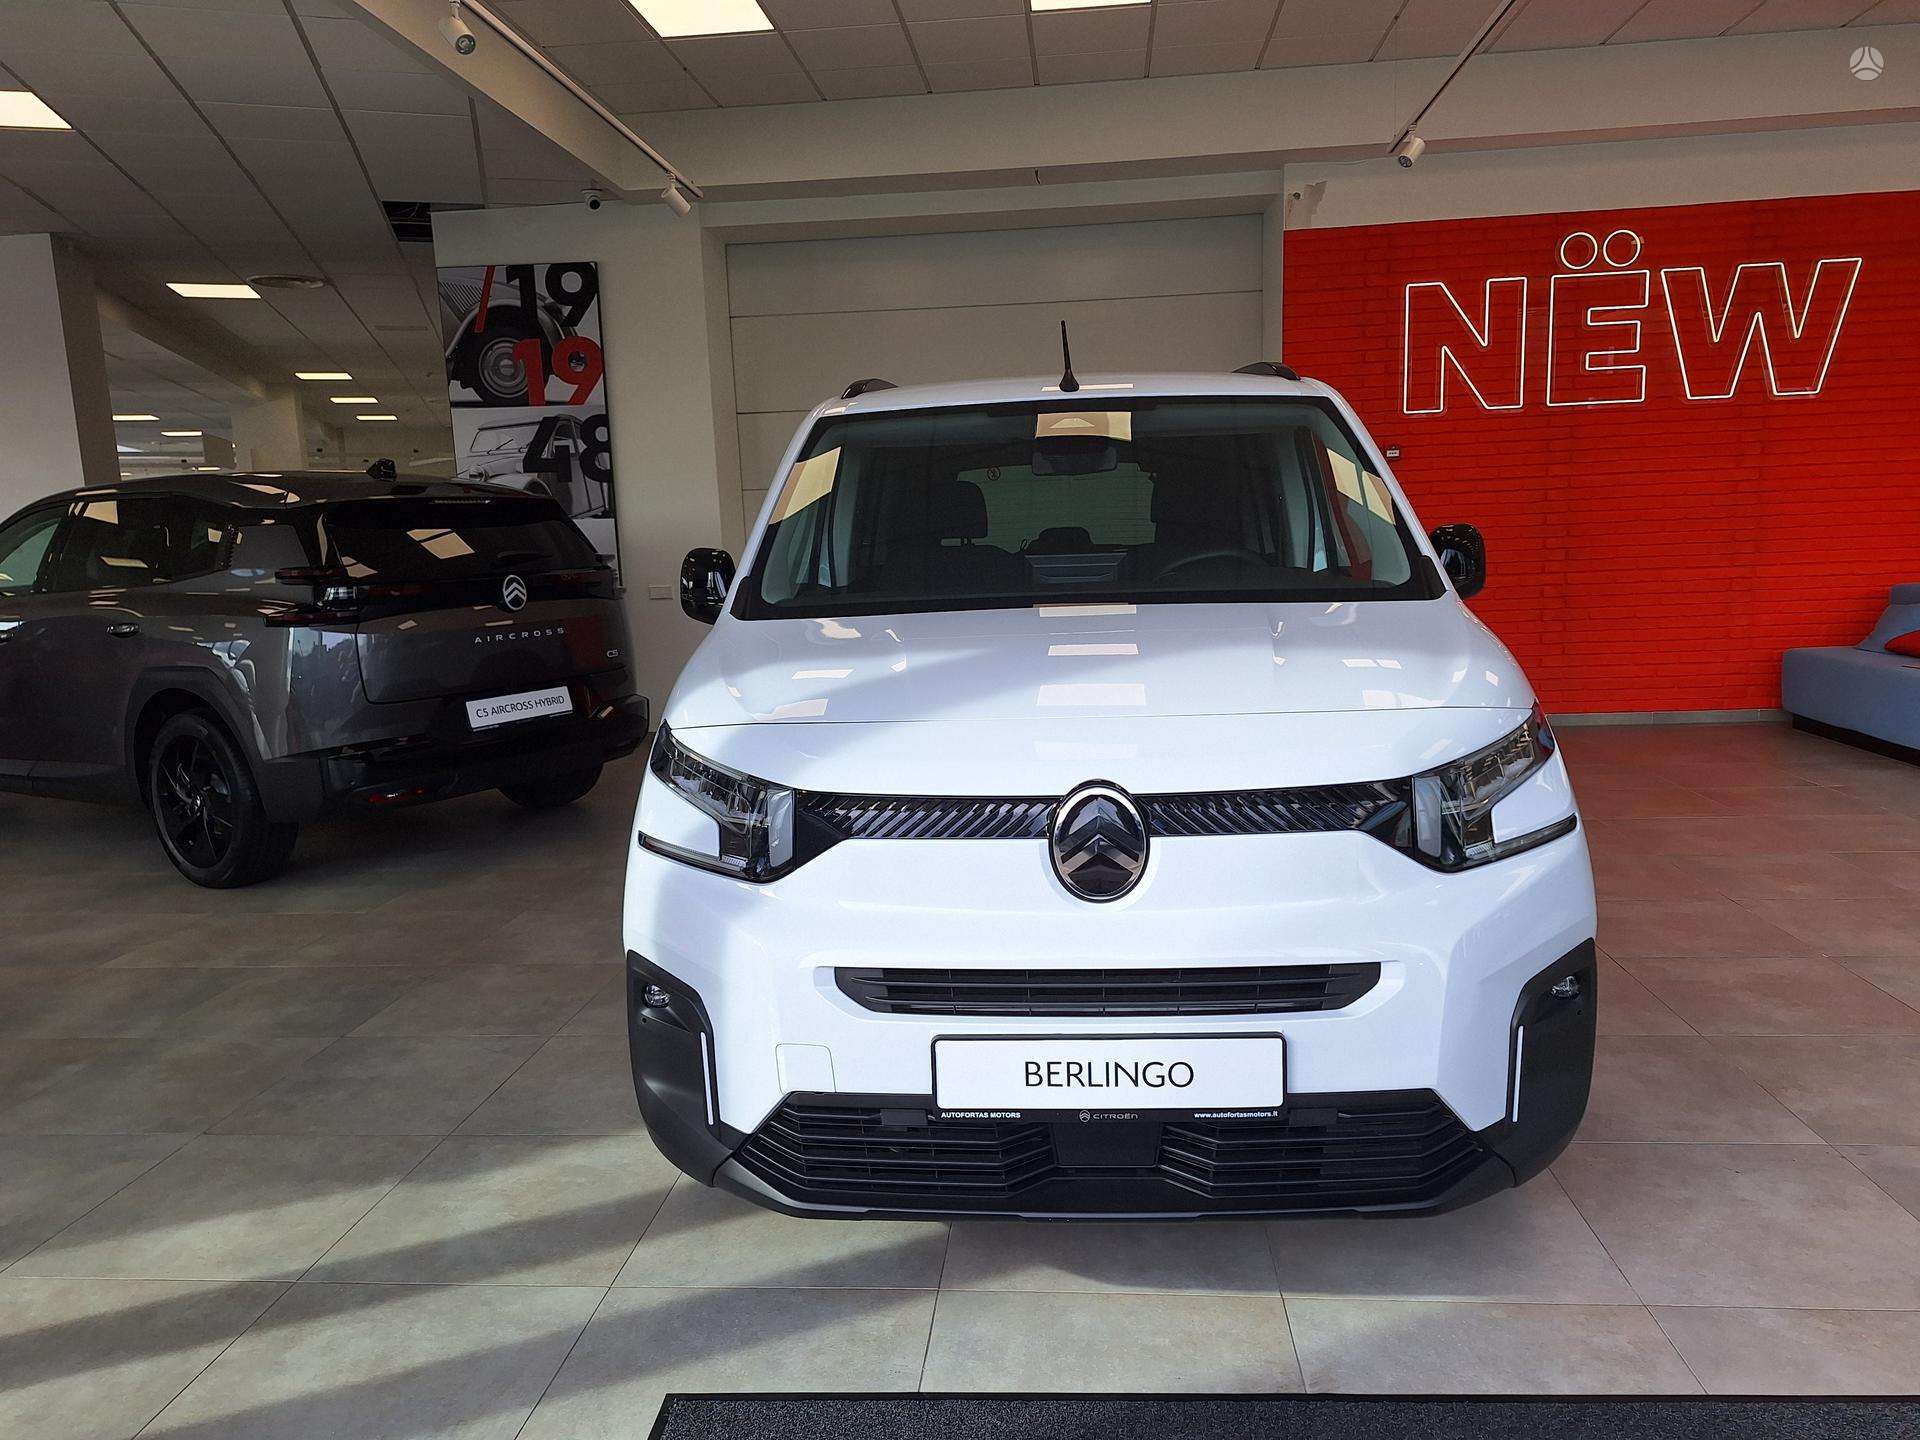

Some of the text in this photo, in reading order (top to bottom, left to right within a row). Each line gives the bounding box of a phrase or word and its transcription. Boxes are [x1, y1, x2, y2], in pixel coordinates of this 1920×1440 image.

[1403, 229, 1863, 414] NËW
[512, 335, 604, 406] 19
[522, 413, 612, 483] 48
[474, 627, 565, 644] AIRCROSS
[476, 695, 565, 718] C5 AIRCROSS HYBRID
[1024, 1061, 1194, 1088] BERLINGO
[941, 1111, 1021, 1119] AUTOFORTAS MOTORS
[1194, 1110, 1279, 1119] www.autofortasmotors.lt
